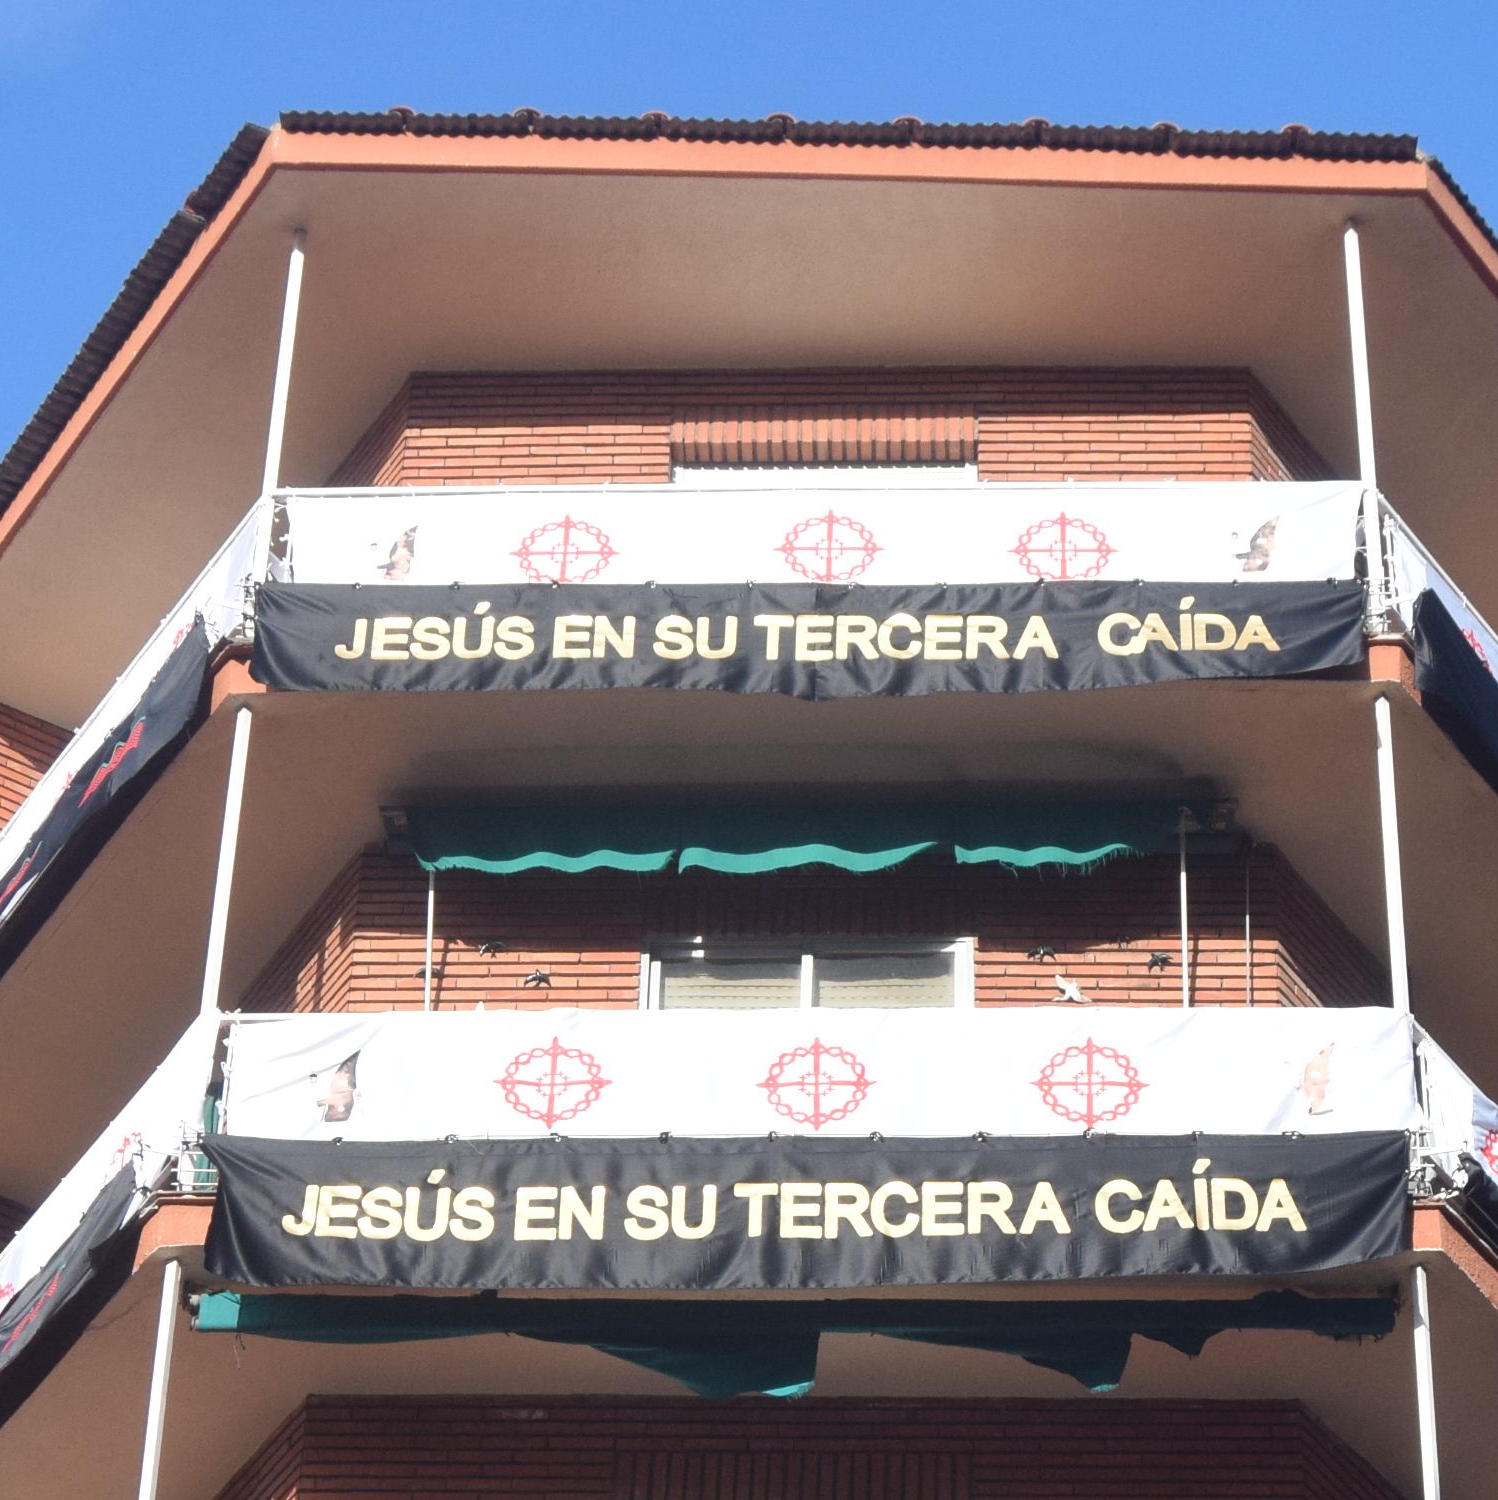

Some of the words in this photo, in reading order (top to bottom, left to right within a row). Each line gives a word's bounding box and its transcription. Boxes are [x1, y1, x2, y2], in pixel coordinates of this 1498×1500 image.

[335, 601, 536, 662] JESÚS
[552, 613, 637, 660] EN
[653, 613, 739, 660] SU
[754, 611, 1060, 664] TERCERA
[1098, 596, 1281, 656] CAÍDA
[282, 1168, 499, 1243] JESÚS
[514, 1184, 610, 1242] EN
[624, 1183, 719, 1242] SU
[732, 1177, 1072, 1240] TERCERA
[1094, 1157, 1307, 1234] CAÍDA
